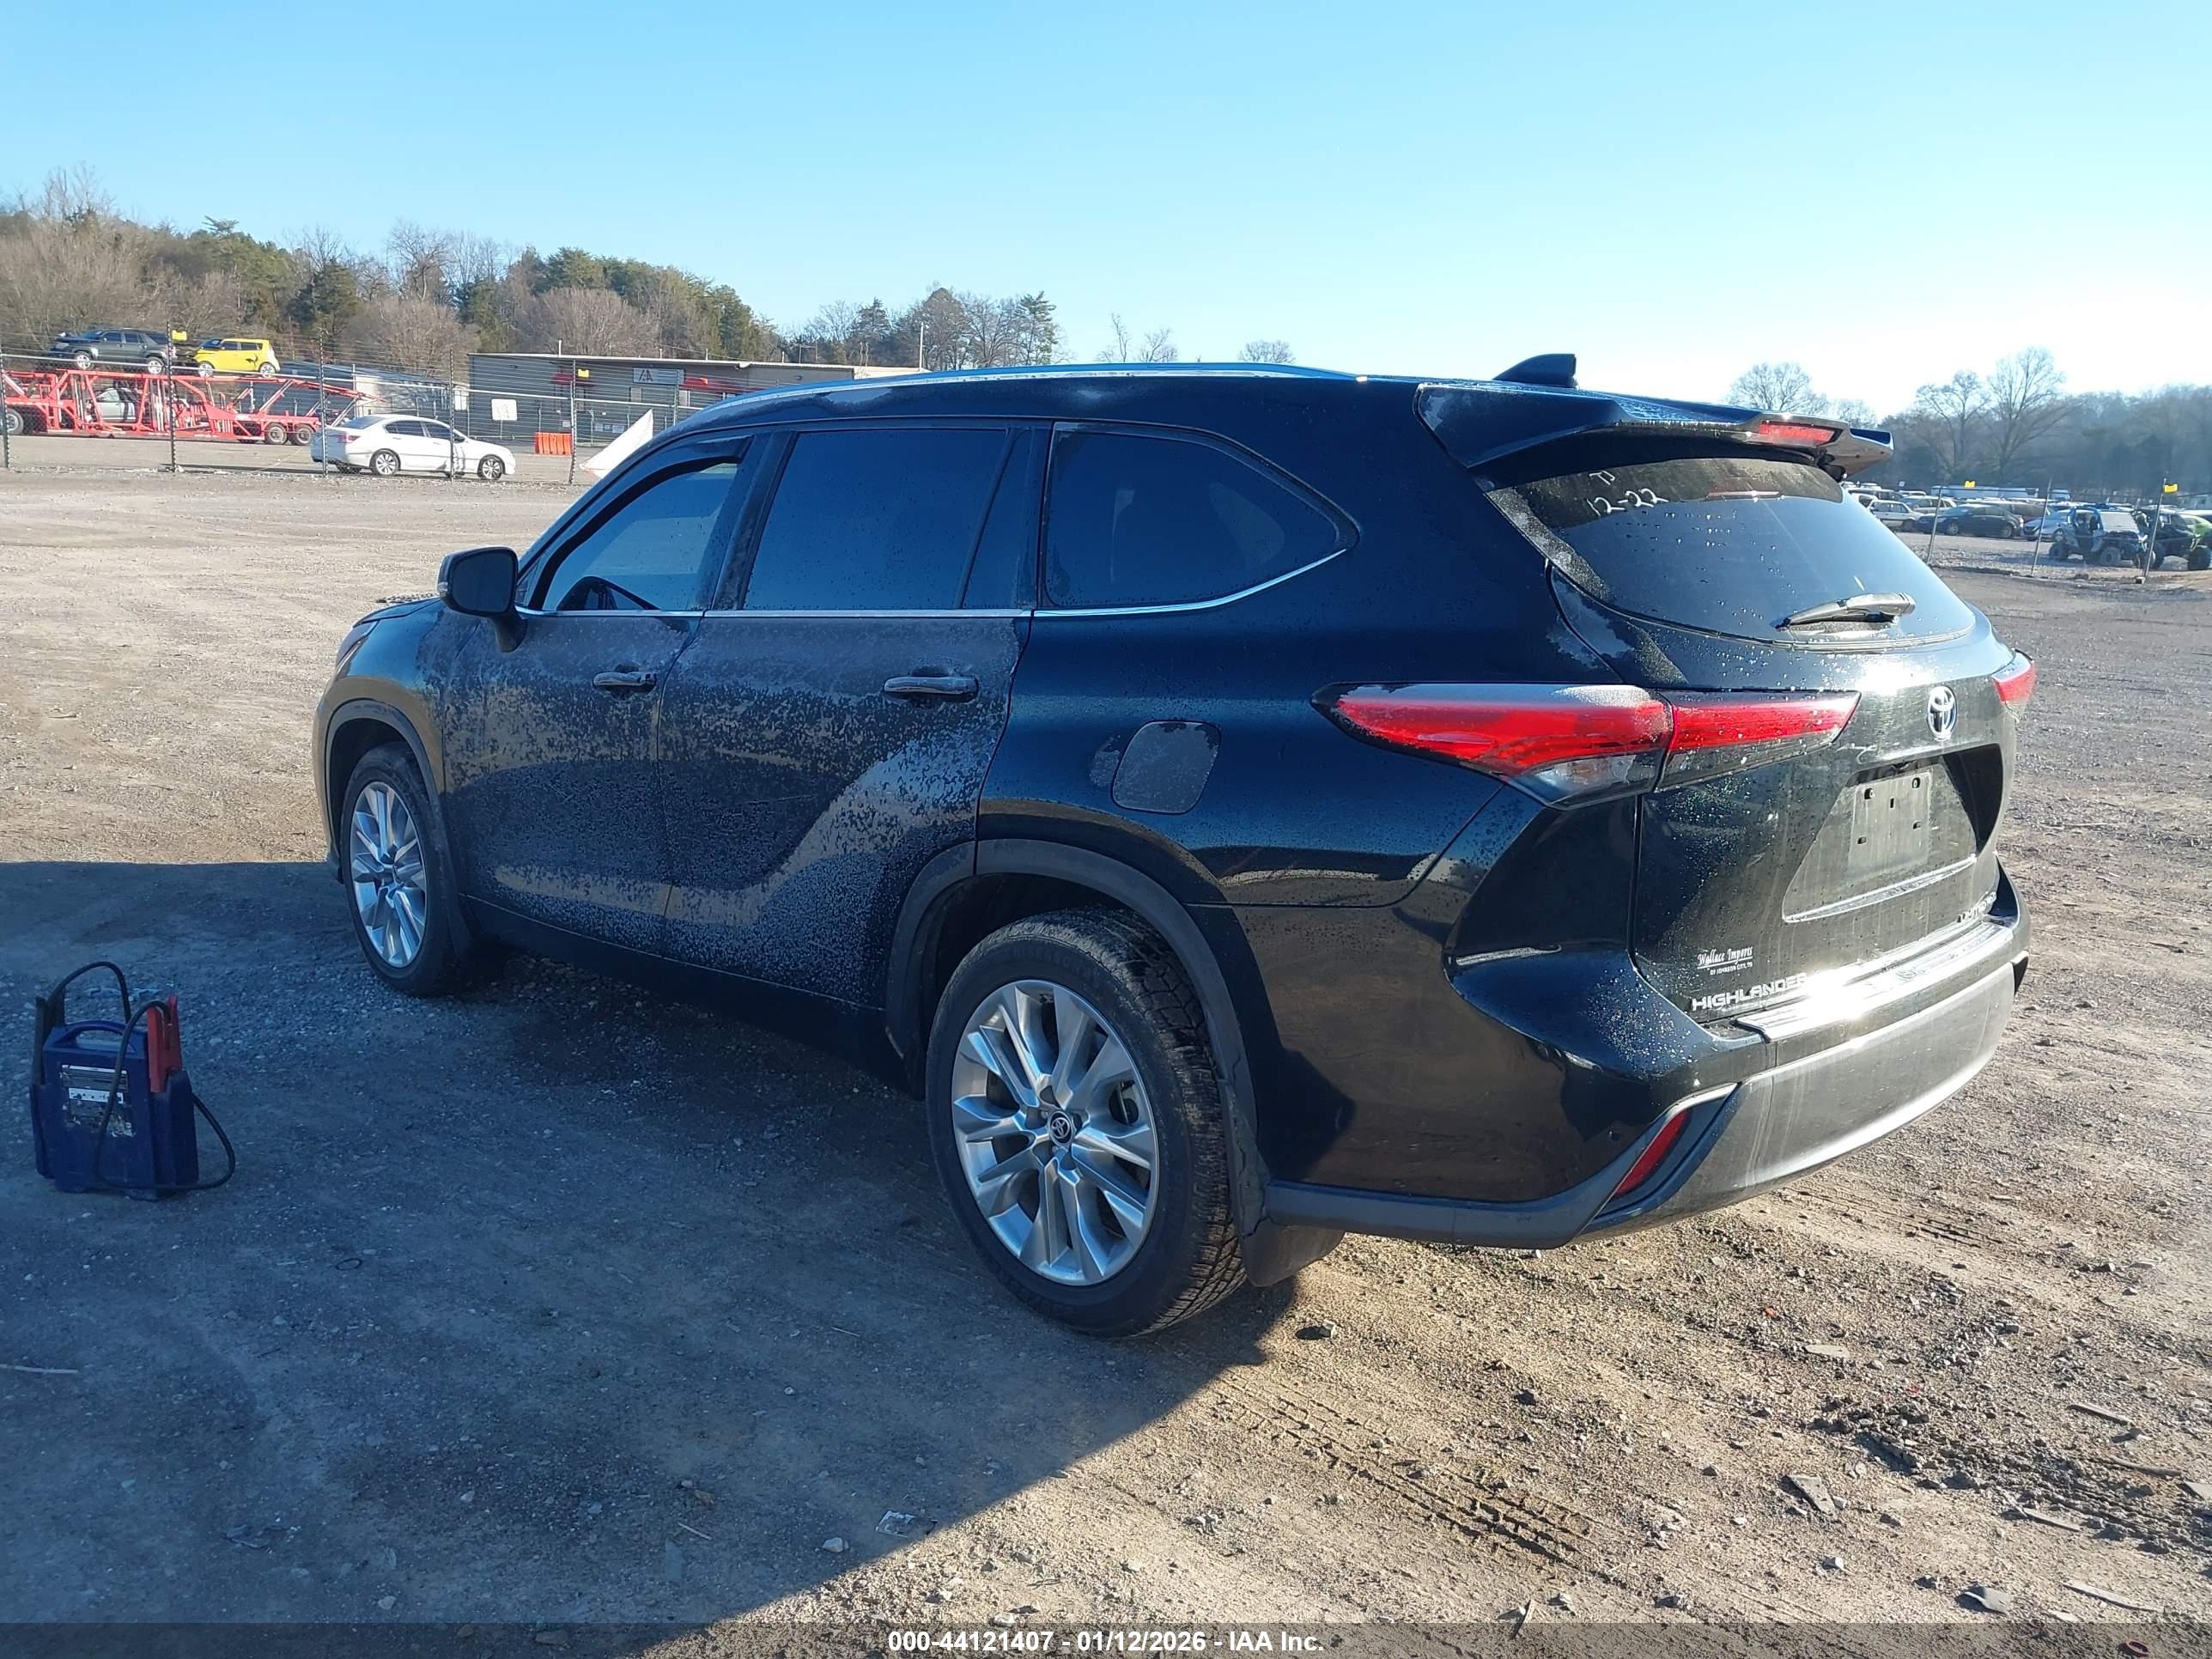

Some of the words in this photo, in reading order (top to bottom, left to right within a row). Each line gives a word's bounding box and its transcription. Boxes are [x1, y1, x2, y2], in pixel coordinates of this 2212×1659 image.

[1586, 488, 1669, 517] 12-22
[1698, 949, 1725, 965] Wallace
[1727, 945, 1753, 964] Imports
[1692, 972, 1806, 1011] HIGHLANDER
